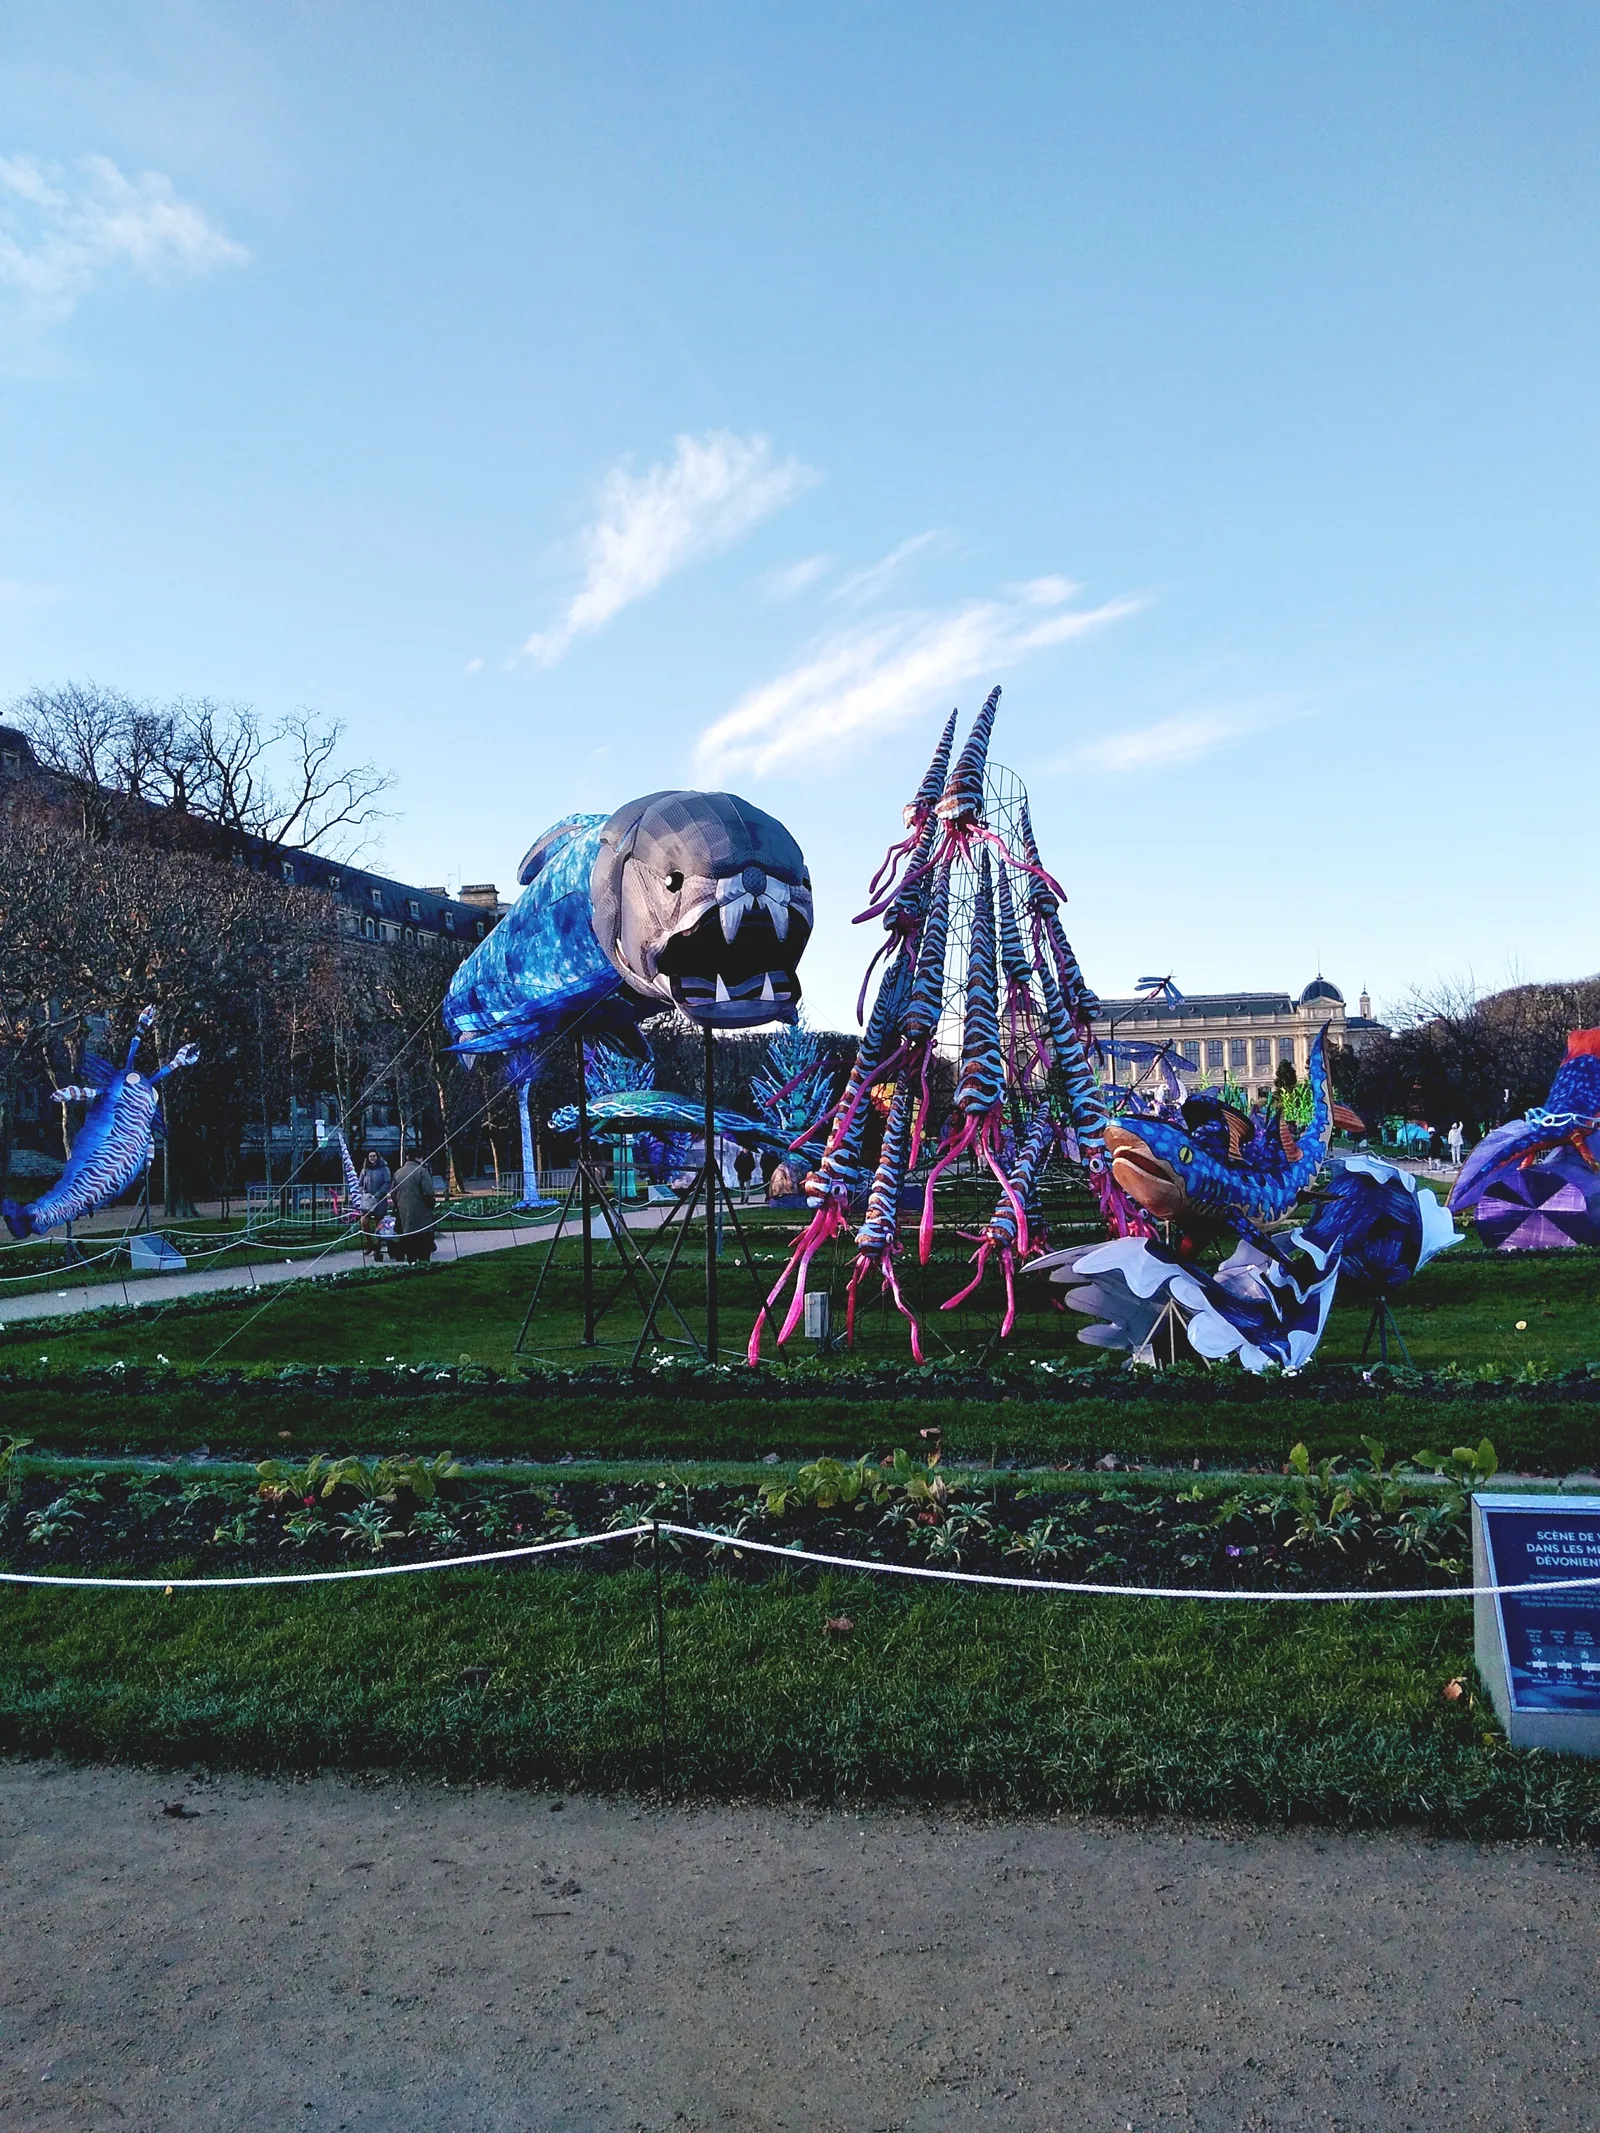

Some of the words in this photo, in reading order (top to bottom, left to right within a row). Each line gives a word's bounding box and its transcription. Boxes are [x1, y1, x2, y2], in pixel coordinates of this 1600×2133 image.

[1536, 1530, 1576, 1541] SCÈNE
[1578, 1532, 1595, 1542] DE
[1526, 1543, 1560, 1553] DANS
[1562, 1544, 1584, 1554] LES
[1535, 1555, 1600, 1567] DÉVONIEN
